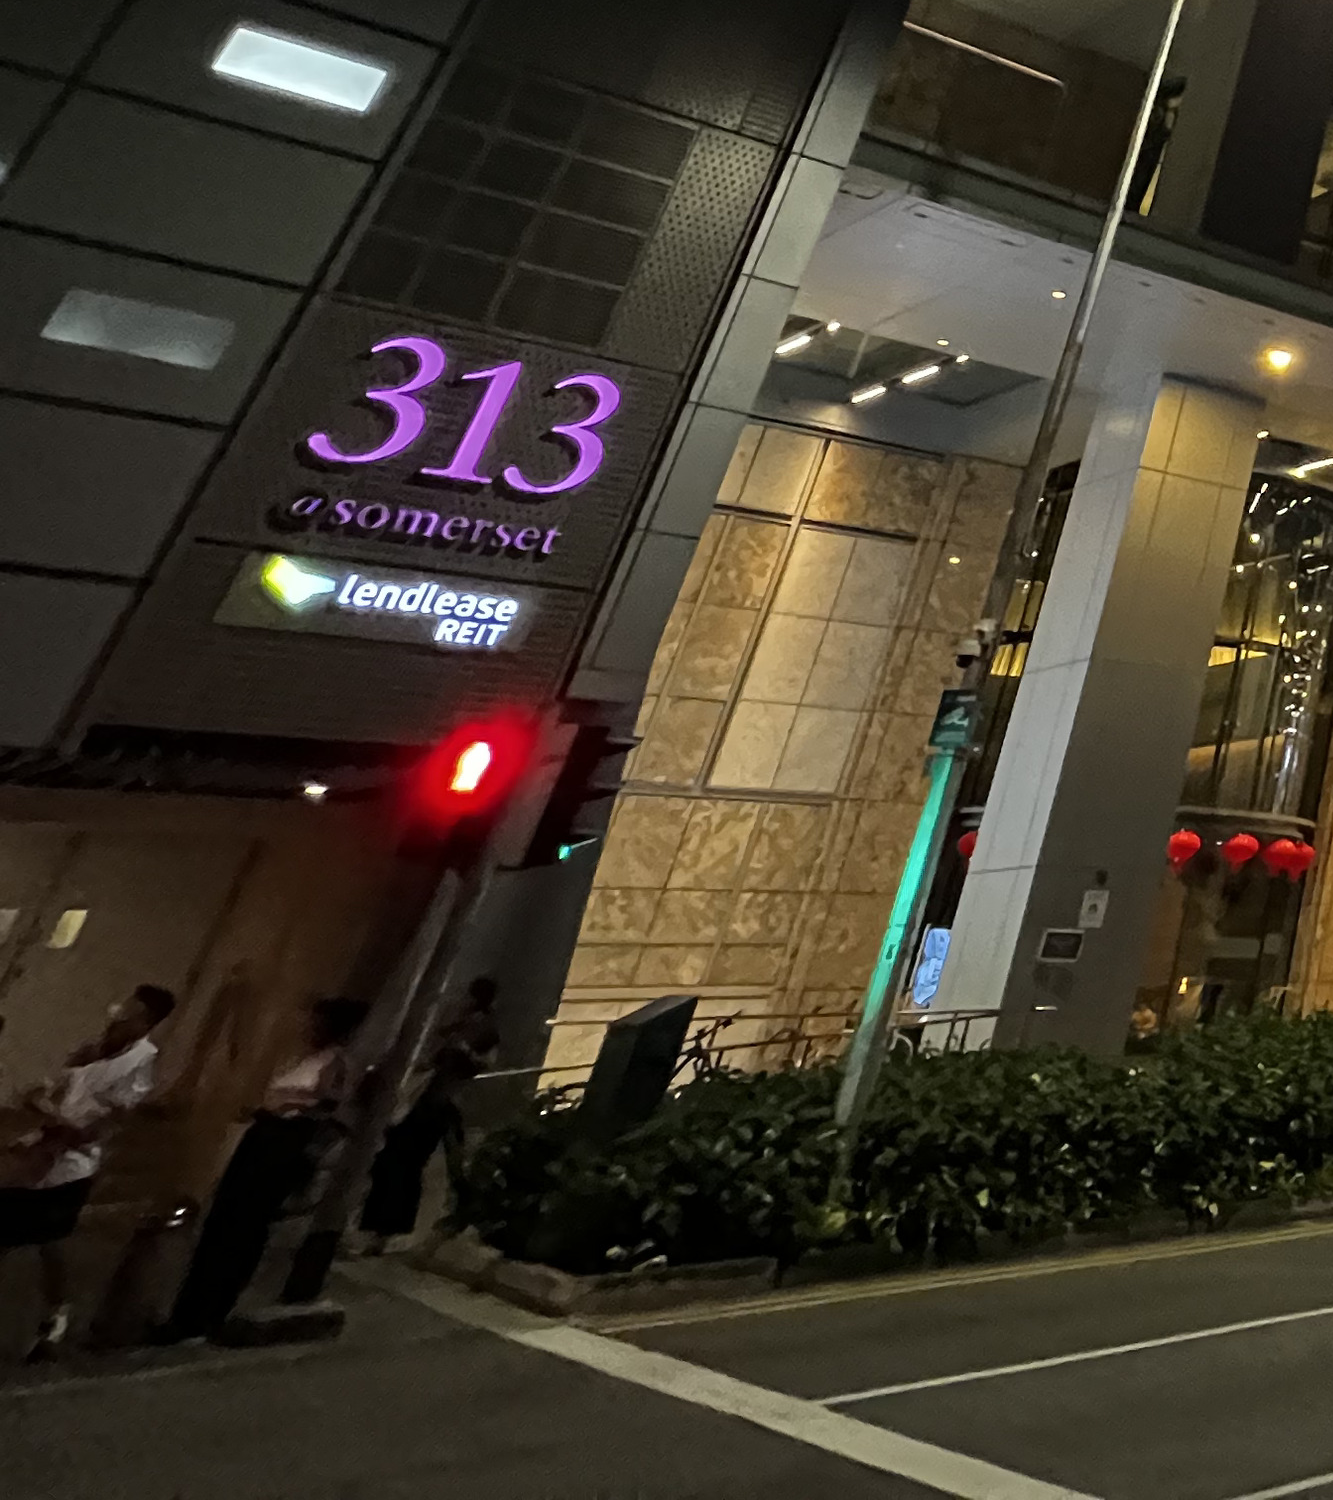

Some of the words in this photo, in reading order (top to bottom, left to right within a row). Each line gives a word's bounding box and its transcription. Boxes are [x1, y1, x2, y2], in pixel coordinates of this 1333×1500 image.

[306, 335, 622, 495] 313
[336, 572, 519, 622] lendlease
[433, 618, 510, 647] REIT
